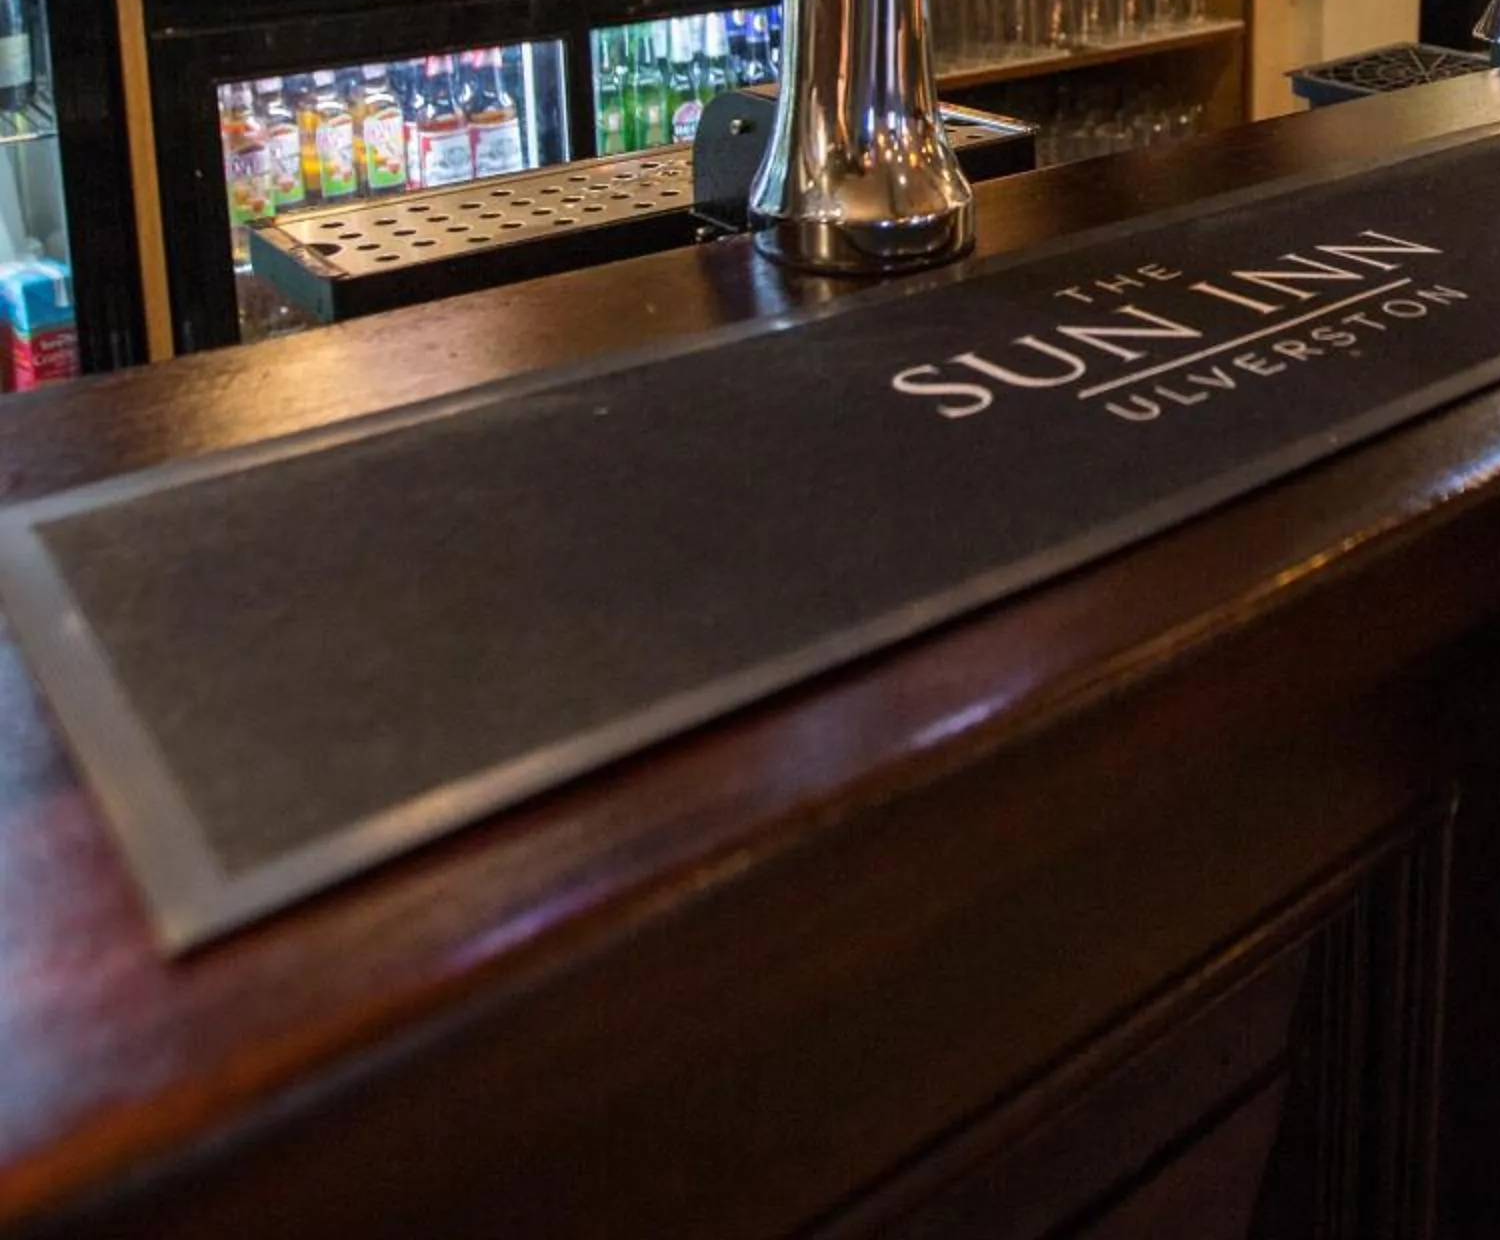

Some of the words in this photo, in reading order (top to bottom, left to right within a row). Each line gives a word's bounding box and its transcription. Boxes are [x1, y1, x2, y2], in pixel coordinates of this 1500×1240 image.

[891, 304, 1204, 420] SUN
[1189, 229, 1444, 315] INN
[1055, 262, 1182, 306] THE
[1106, 283, 1470, 423] ULVERSTON
